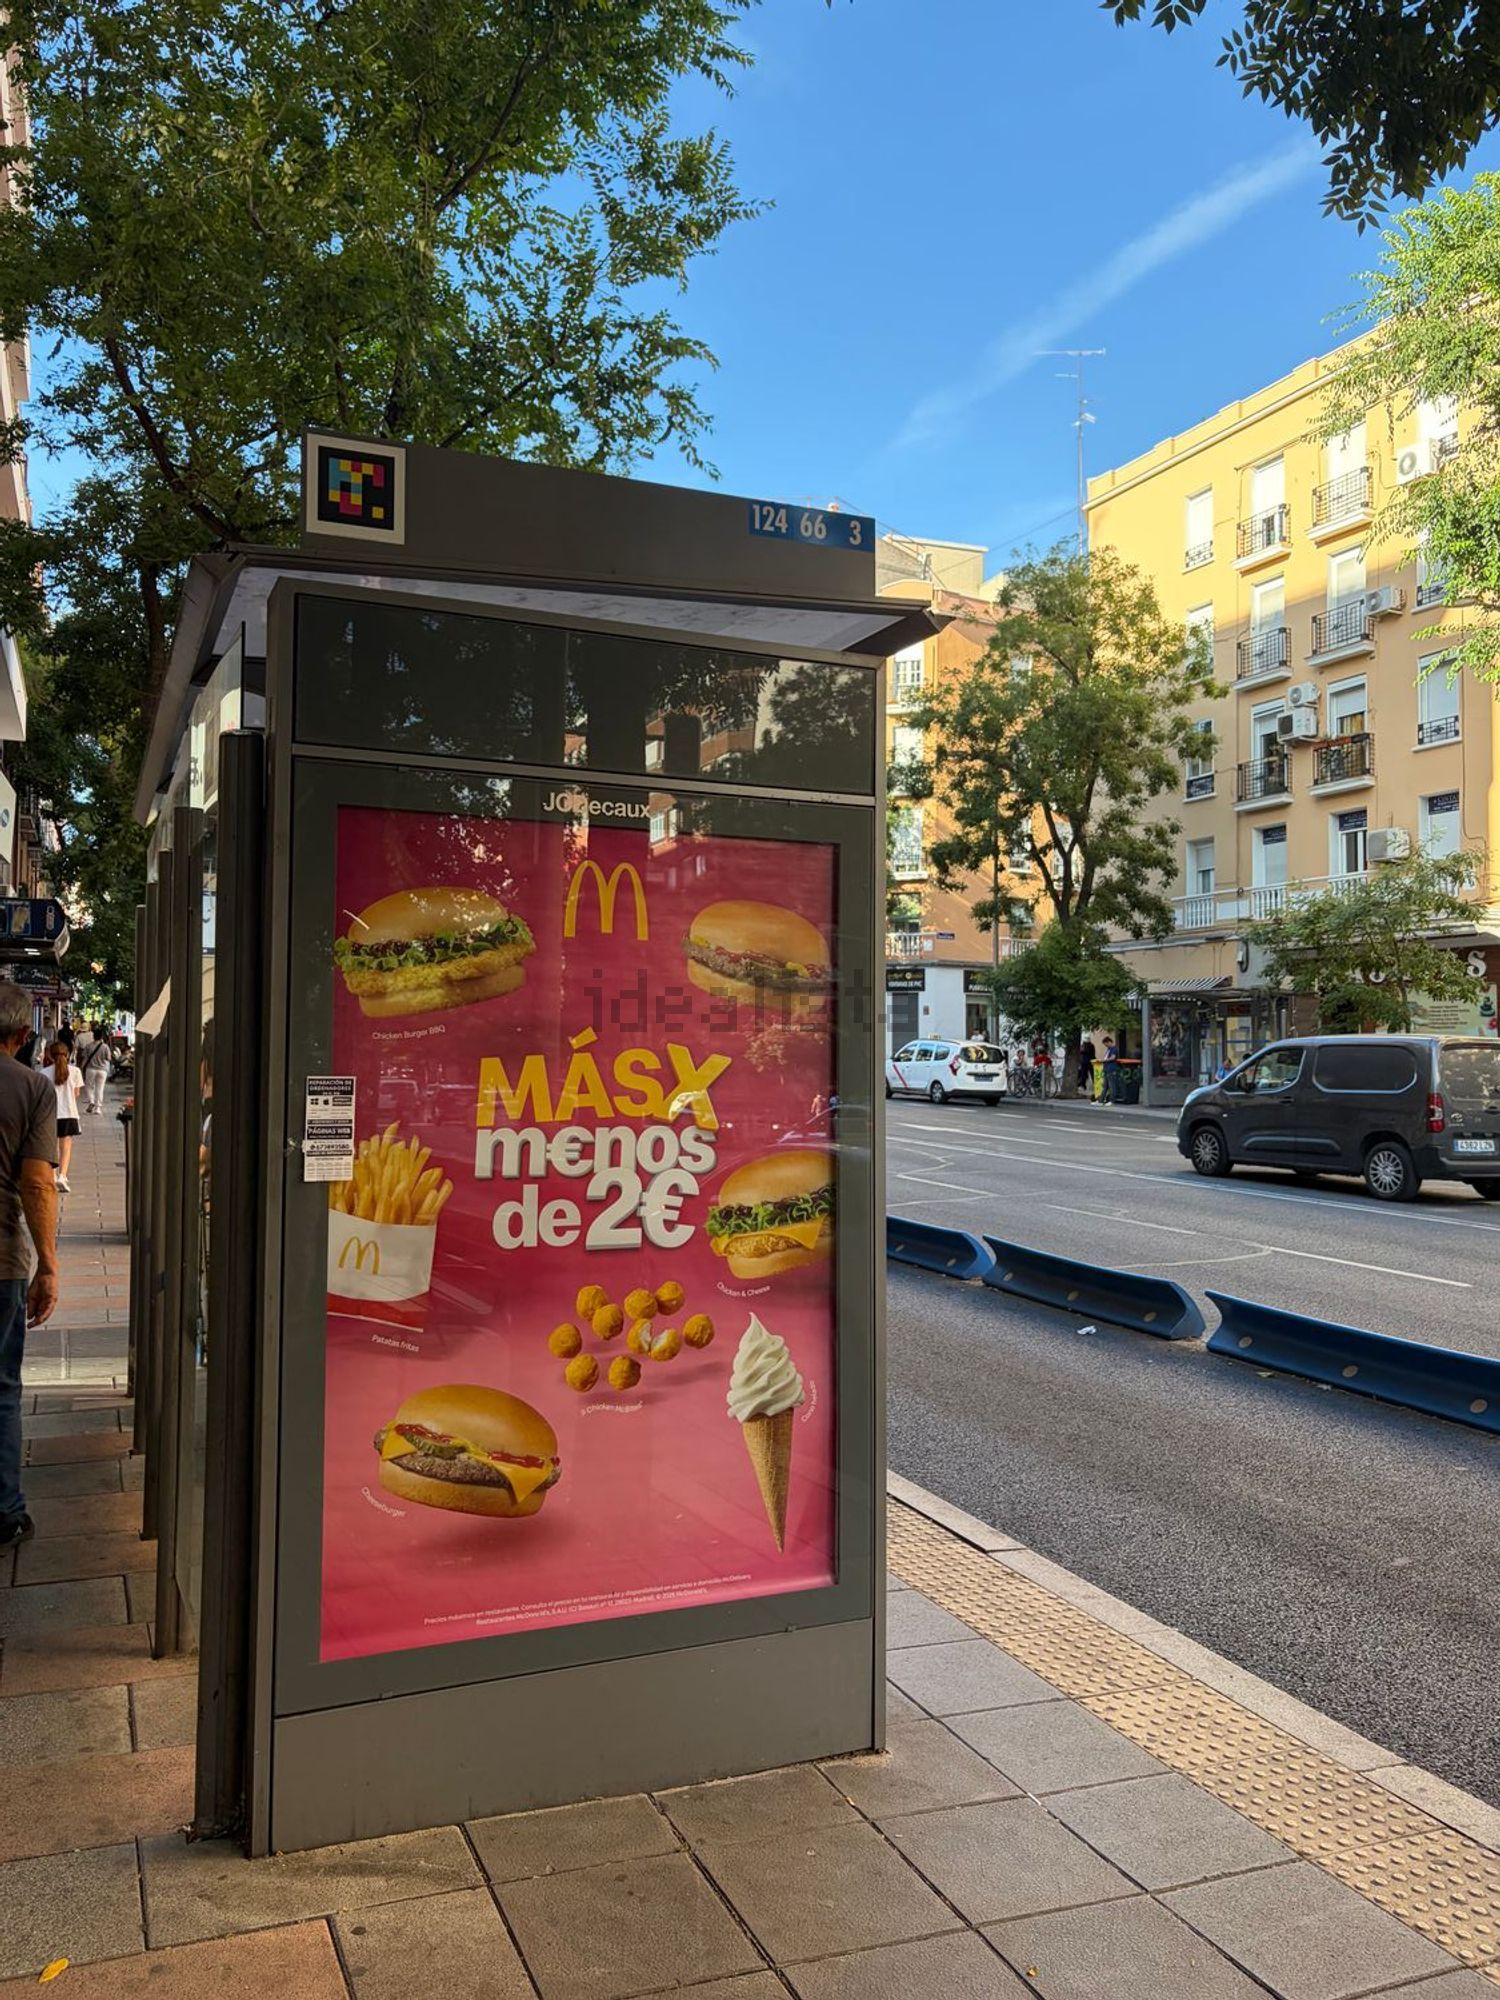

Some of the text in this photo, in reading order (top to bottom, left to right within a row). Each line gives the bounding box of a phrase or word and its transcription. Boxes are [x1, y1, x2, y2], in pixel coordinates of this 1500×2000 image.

[752, 504, 862, 545] 124 66 3
[492, 1184, 582, 1251] de
